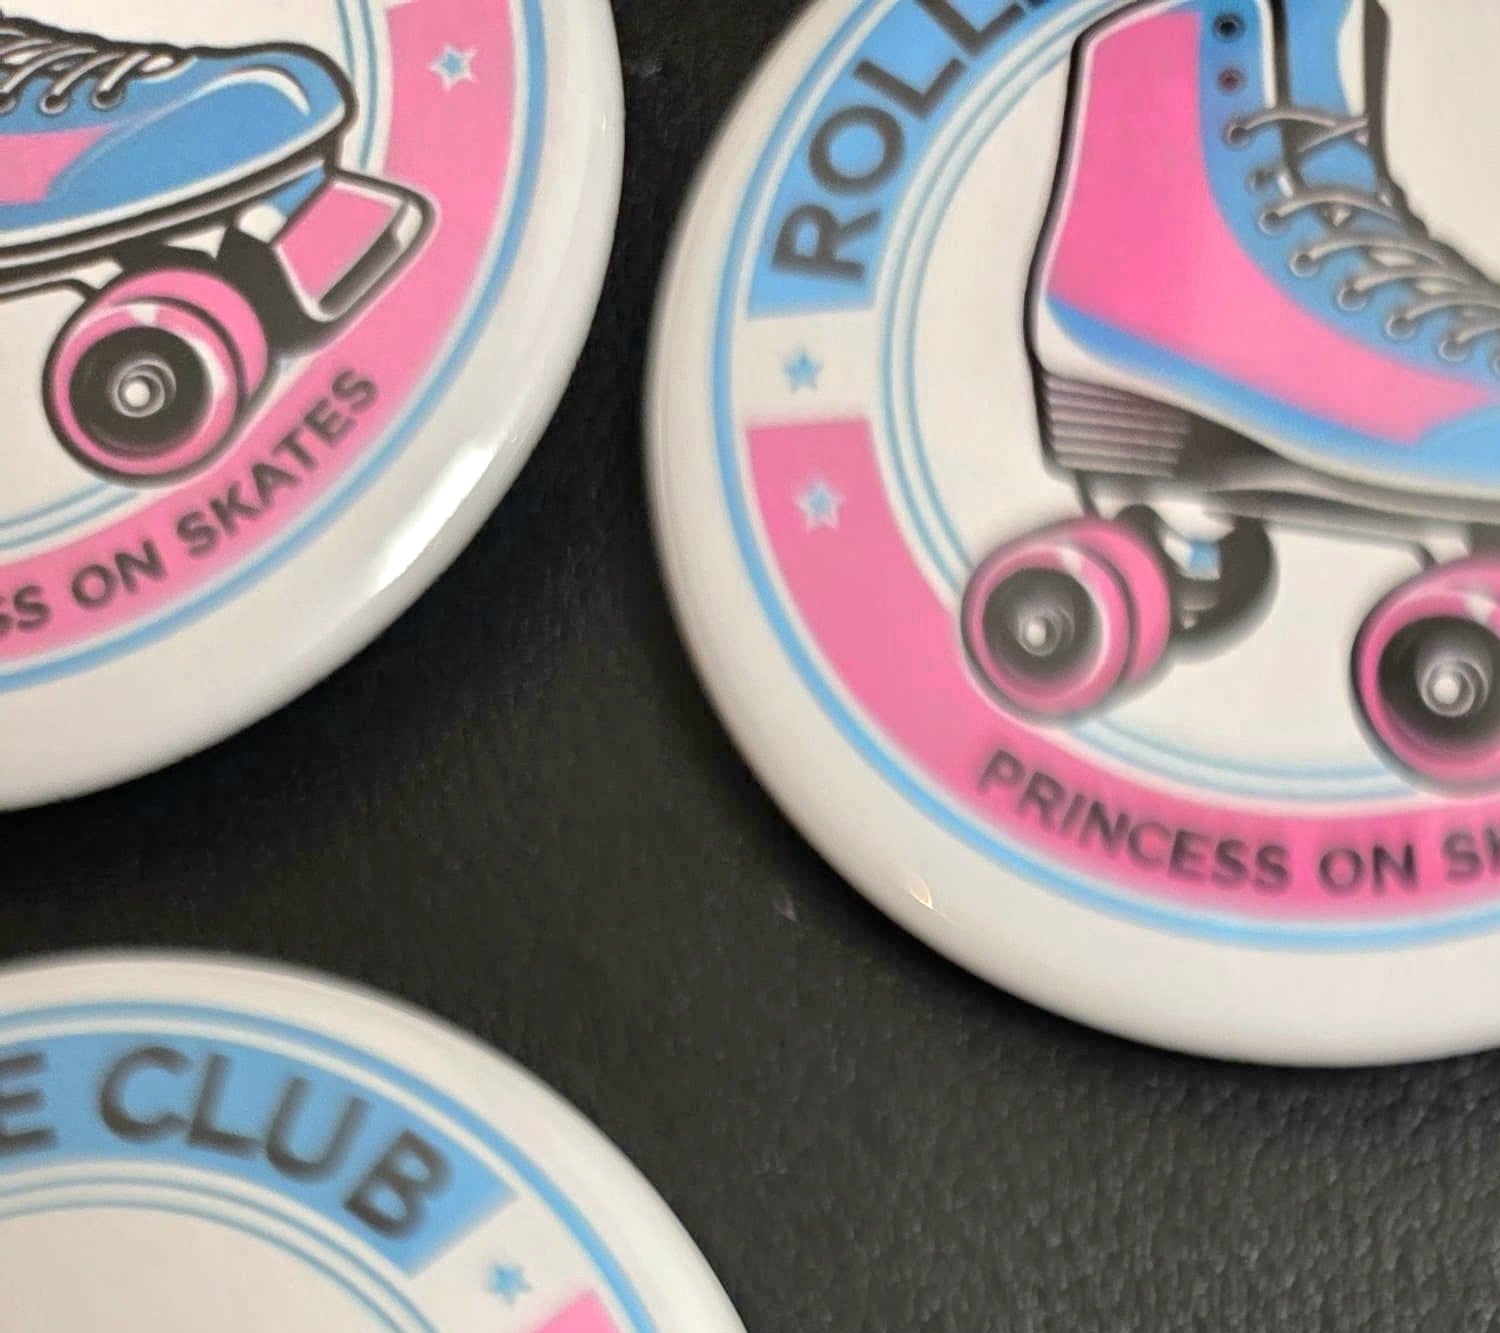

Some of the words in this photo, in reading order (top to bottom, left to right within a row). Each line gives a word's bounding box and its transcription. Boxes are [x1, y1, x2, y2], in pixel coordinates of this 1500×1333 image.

[771, 0, 1049, 284] ROLL
[71, 537, 167, 609] ON
[176, 369, 380, 559] SKATES
[977, 750, 1292, 895] PRINCESS
[1318, 843, 1417, 897] ON
[97, 1047, 453, 1239] CLUB
